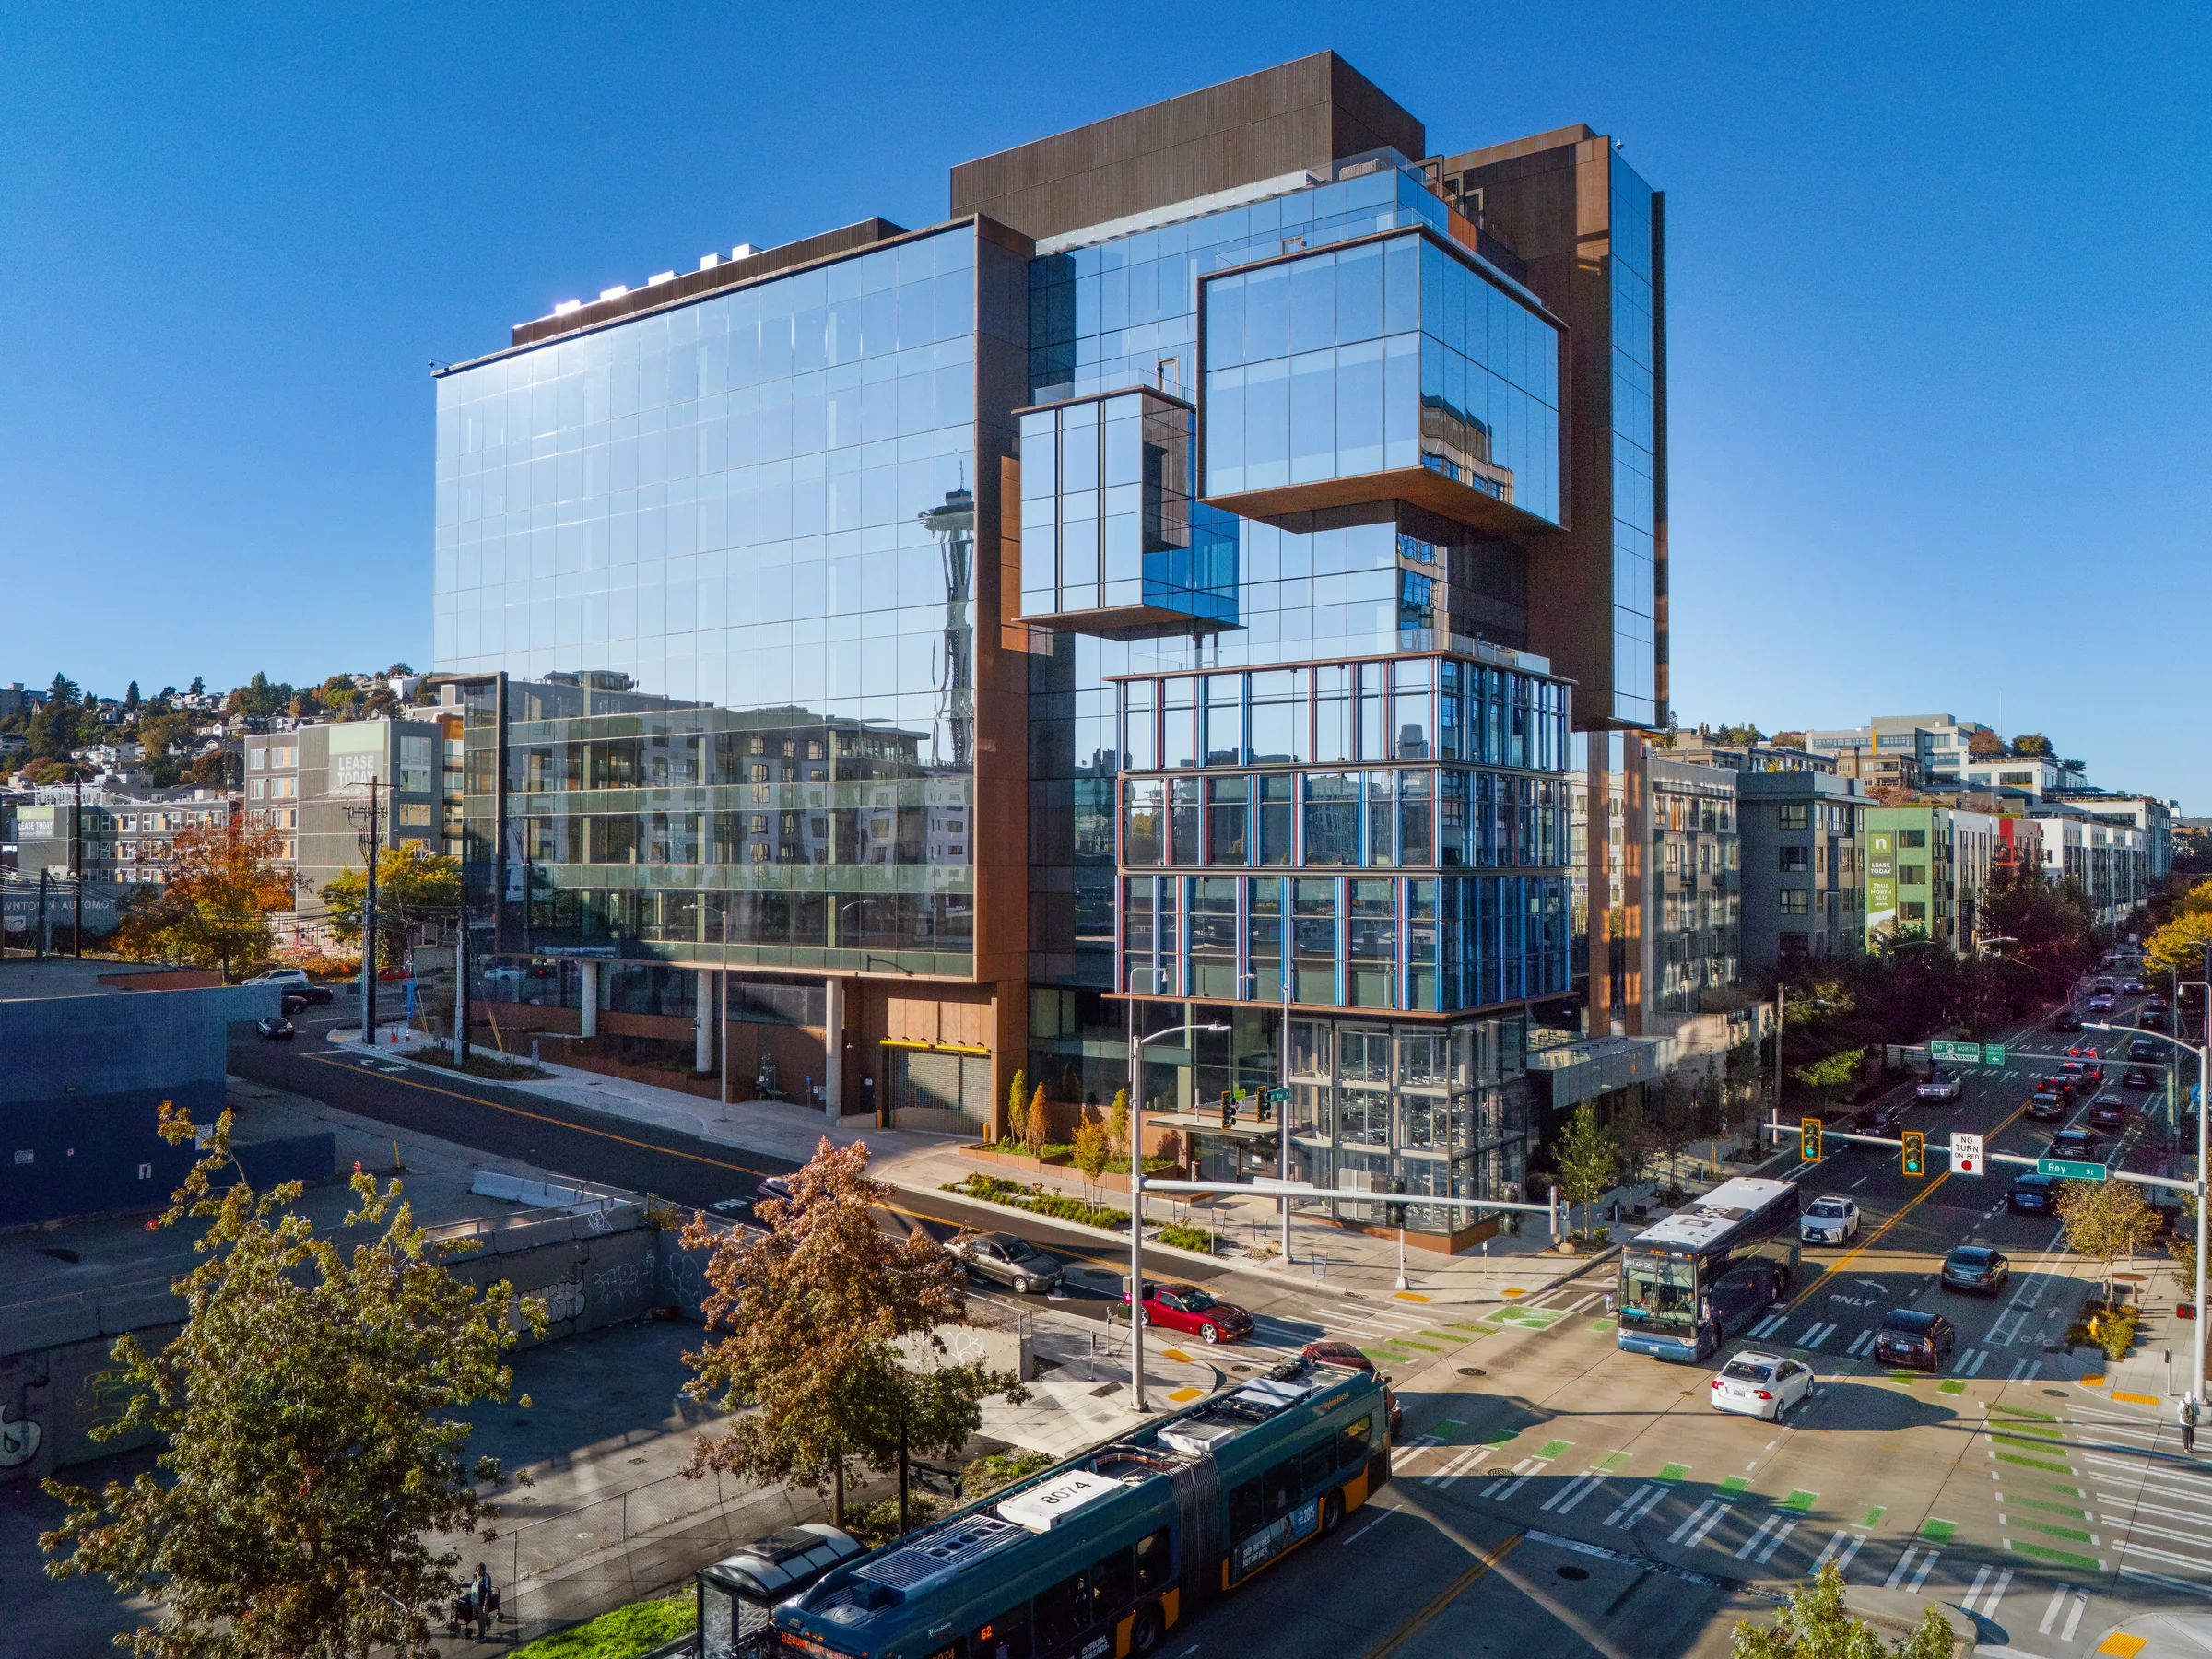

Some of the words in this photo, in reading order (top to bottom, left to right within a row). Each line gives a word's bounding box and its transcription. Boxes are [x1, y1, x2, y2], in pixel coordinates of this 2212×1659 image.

[337, 755, 374, 771] LEASE
[337, 771, 374, 786] TODAY
[18, 821, 35, 830] LEASE
[36, 821, 53, 830] TODAY
[1875, 838, 1887, 849] n
[1960, 1135, 1973, 1145] NO
[1955, 1144, 1980, 1153] TURN
[2048, 1162, 2066, 1174] Roy
[1828, 1294, 1877, 1307] ONLY
[1040, 1480, 1092, 1504] 8074
[981, 1625, 993, 1640] 62
[1081, 1634, 1107, 1655] OFFICIAL
[932, 1647, 955, 1659] 074
